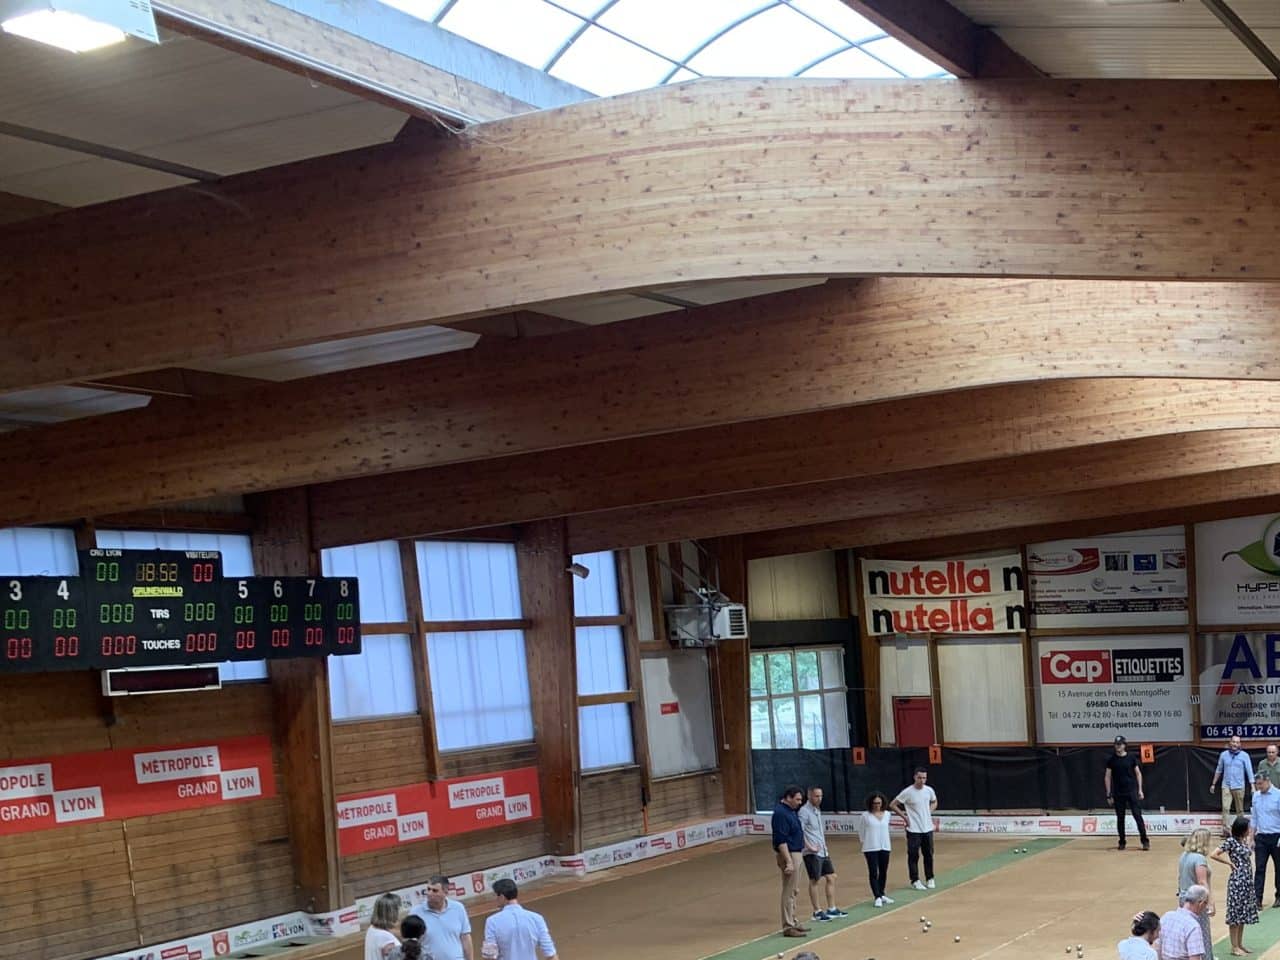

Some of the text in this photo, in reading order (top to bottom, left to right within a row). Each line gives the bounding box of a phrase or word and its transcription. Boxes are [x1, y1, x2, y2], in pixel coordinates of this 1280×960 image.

[238, 578, 349, 599] 5 6 7 8
[868, 561, 992, 596] nutella
[9, 580, 70, 601] 3 4
[150, 608, 171, 619] TIRS
[872, 599, 995, 633] nutella
[142, 639, 181, 650] TOUCHES
[1050, 653, 1182, 683] Cap ETIQUETTES
[1067, 689, 1093, 698] Avenue
[1094, 689, 1106, 697] des
[1129, 687, 1171, 699] Montgolfier
[1110, 699, 1143, 708] Chassieu
[1218, 709, 1269, 720] Placements,
[1230, 701, 1268, 710] Courtage
[1071, 720, 1160, 730] www.capetiquettes.com
[1206, 726, 1219, 737] 06
[1221, 726, 1234, 737] 45
[1236, 726, 1248, 736] 81
[1252, 725, 1265, 736] 22
[1266, 725, 1279, 736] 61
[140, 752, 215, 776] MÉTROPOLE
[1143, 748, 1152, 761] 6
[177, 772, 255, 800] GRAND LYON
[452, 782, 501, 803] MÉTROPOLE
[0, 793, 96, 822] GRAND LYON
[337, 800, 394, 823] MÉTROPOLE
[475, 798, 529, 821] GRAND LYON
[363, 817, 425, 842] GRAND LYON
[1149, 823, 1168, 832] LYON
[284, 925, 305, 936] LYON
